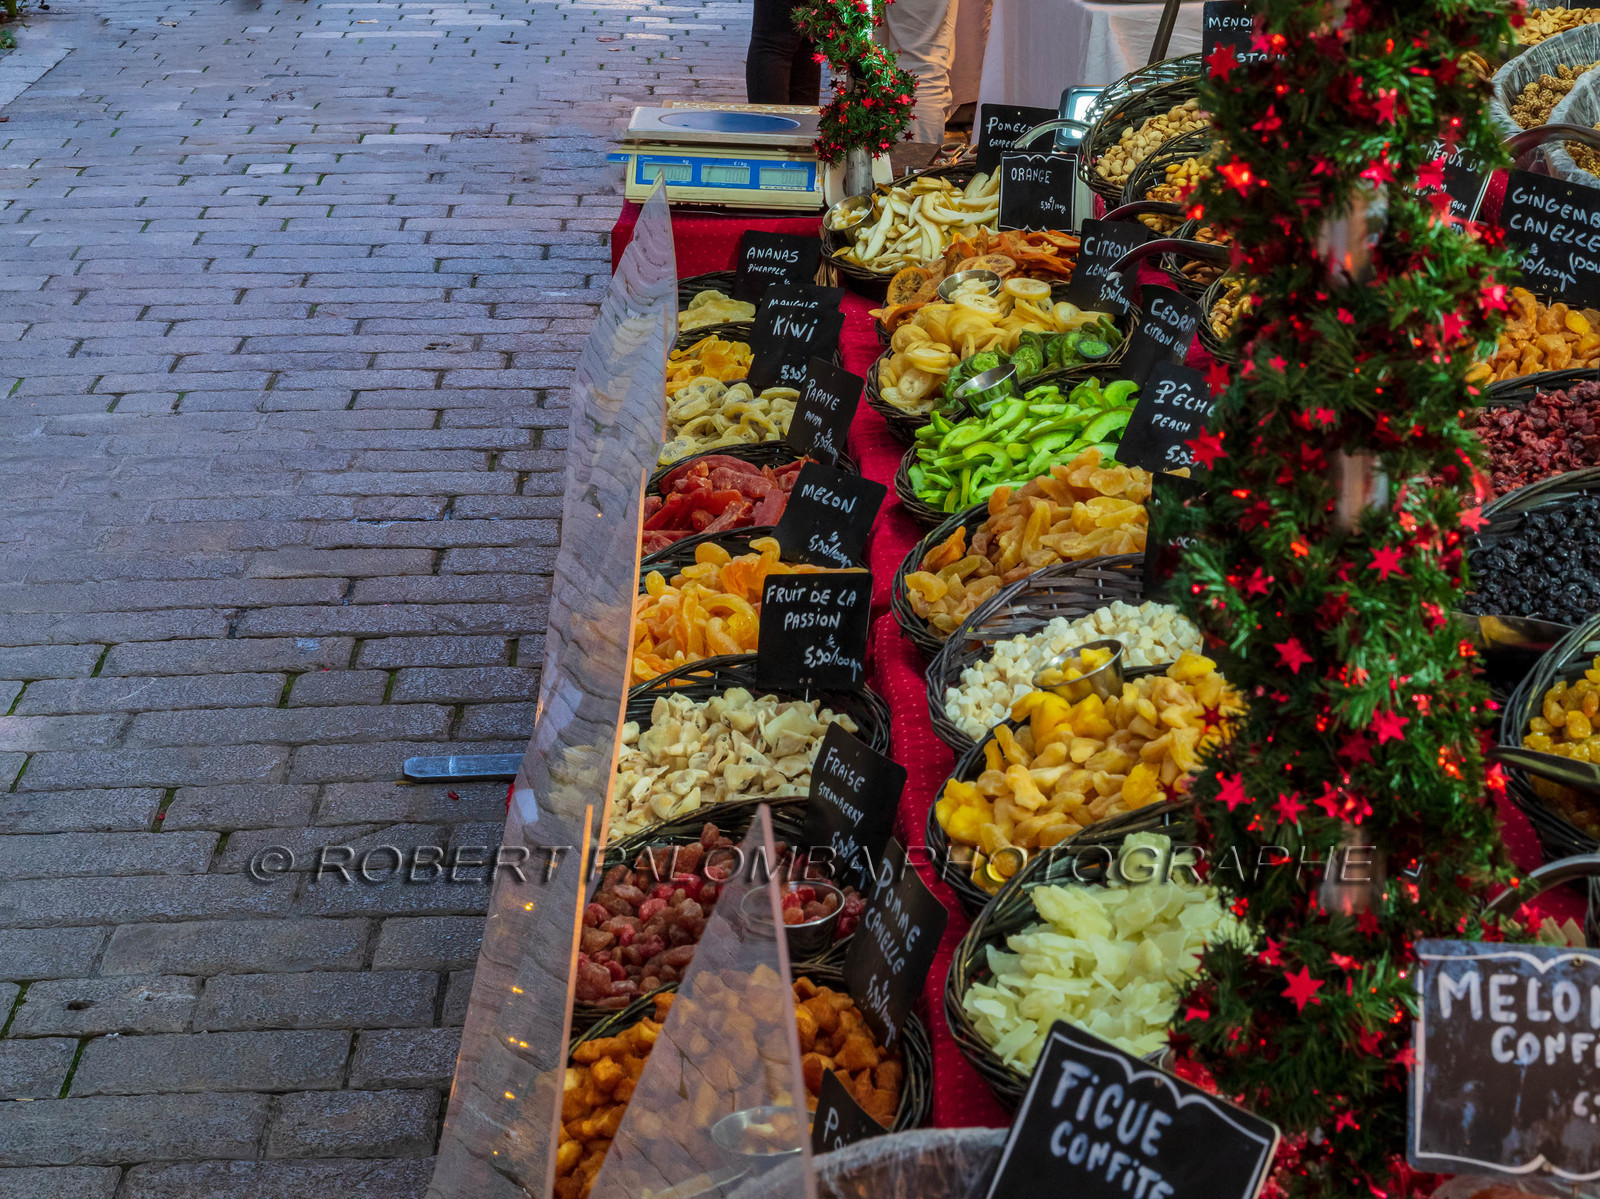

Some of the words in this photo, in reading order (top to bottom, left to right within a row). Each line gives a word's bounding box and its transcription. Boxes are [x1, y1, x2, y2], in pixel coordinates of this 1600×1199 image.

[1011, 167, 1052, 184] ORANGE
[1510, 213, 1600, 252] CANELLE
[746, 246, 798, 262] ANANAS
[748, 263, 786, 276] PiNEAPPLE
[805, 378, 840, 411] PAPAYE
[1152, 413, 1191, 433] PEACH
[801, 484, 857, 513] MELON
[766, 581, 806, 604] FRUiT
[810, 589, 831, 605] DE
[837, 590, 856, 607] LA
[784, 608, 840, 631] PASSiON
[822, 746, 866, 792] FRAiSE
[874, 857, 921, 952] POMME
[865, 907, 905, 975] CANELLE
